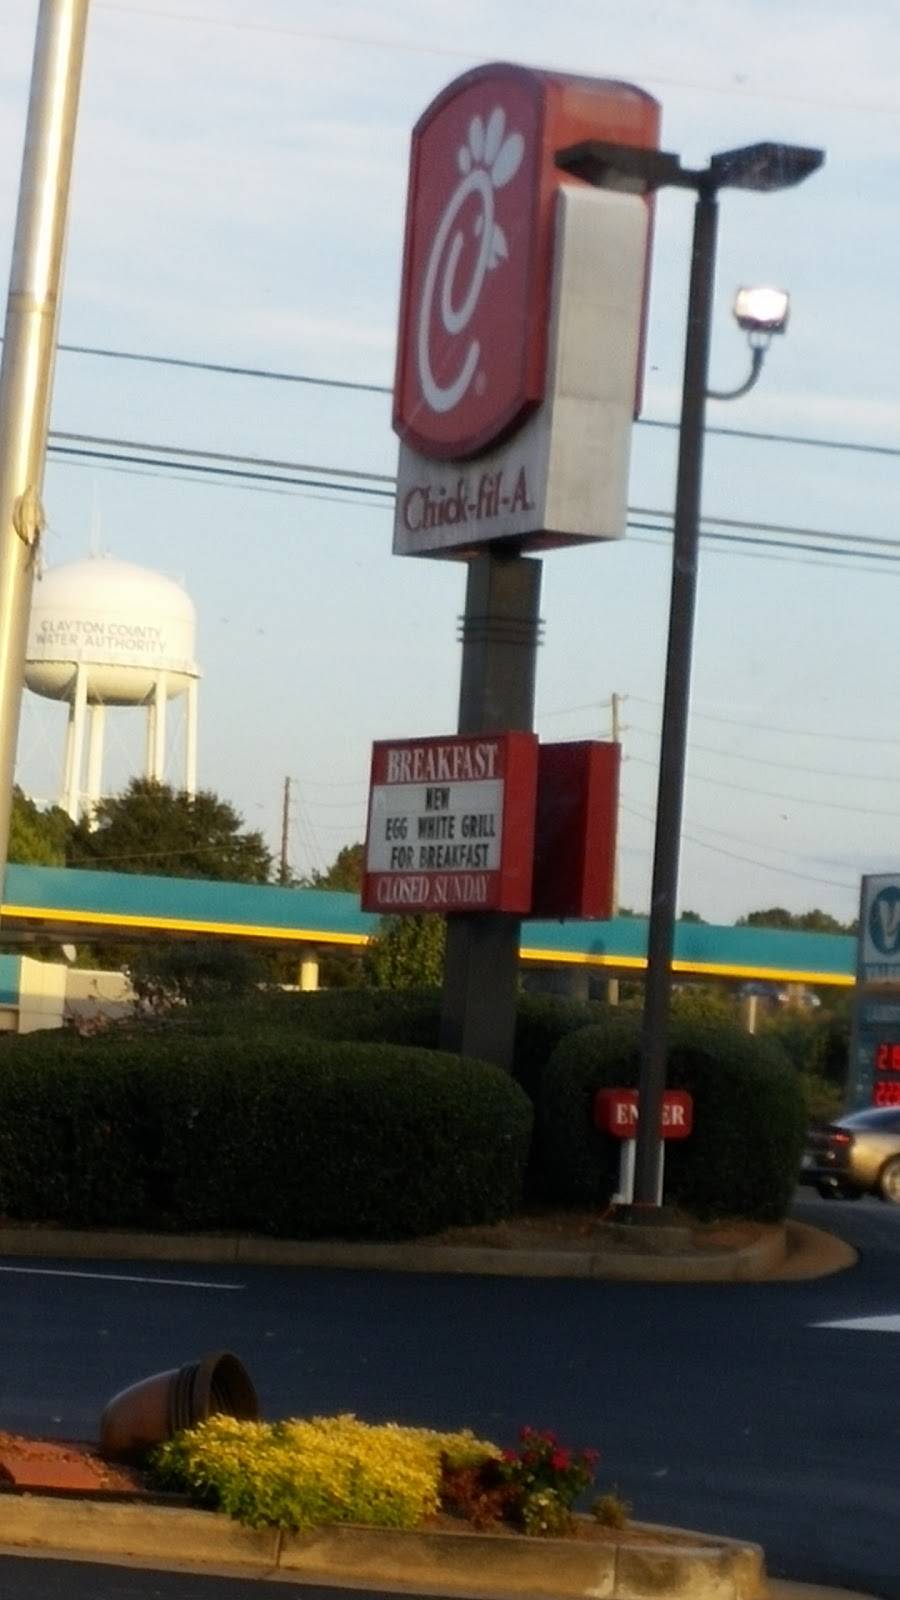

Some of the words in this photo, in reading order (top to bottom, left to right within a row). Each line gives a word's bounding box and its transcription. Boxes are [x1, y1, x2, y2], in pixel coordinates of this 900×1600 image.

[41, 620, 105, 634] CLAYTON
[108, 623, 162, 638] COUNTY
[36, 633, 78, 646] WATER
[84, 635, 167, 653] AUTHORITY
[387, 744, 498, 783] BREAKFAST
[425, 787, 450, 812] NEW
[385, 818, 408, 841] EGG
[417, 815, 455, 840] WHITE
[461, 813, 496, 838] GRILL
[390, 846, 415, 869] FOR
[419, 843, 489, 868] BREAKFAST
[376, 877, 430, 904] CLOSED
[433, 874, 490, 903] SUNDAY
[616, 1103, 685, 1125] ENER
